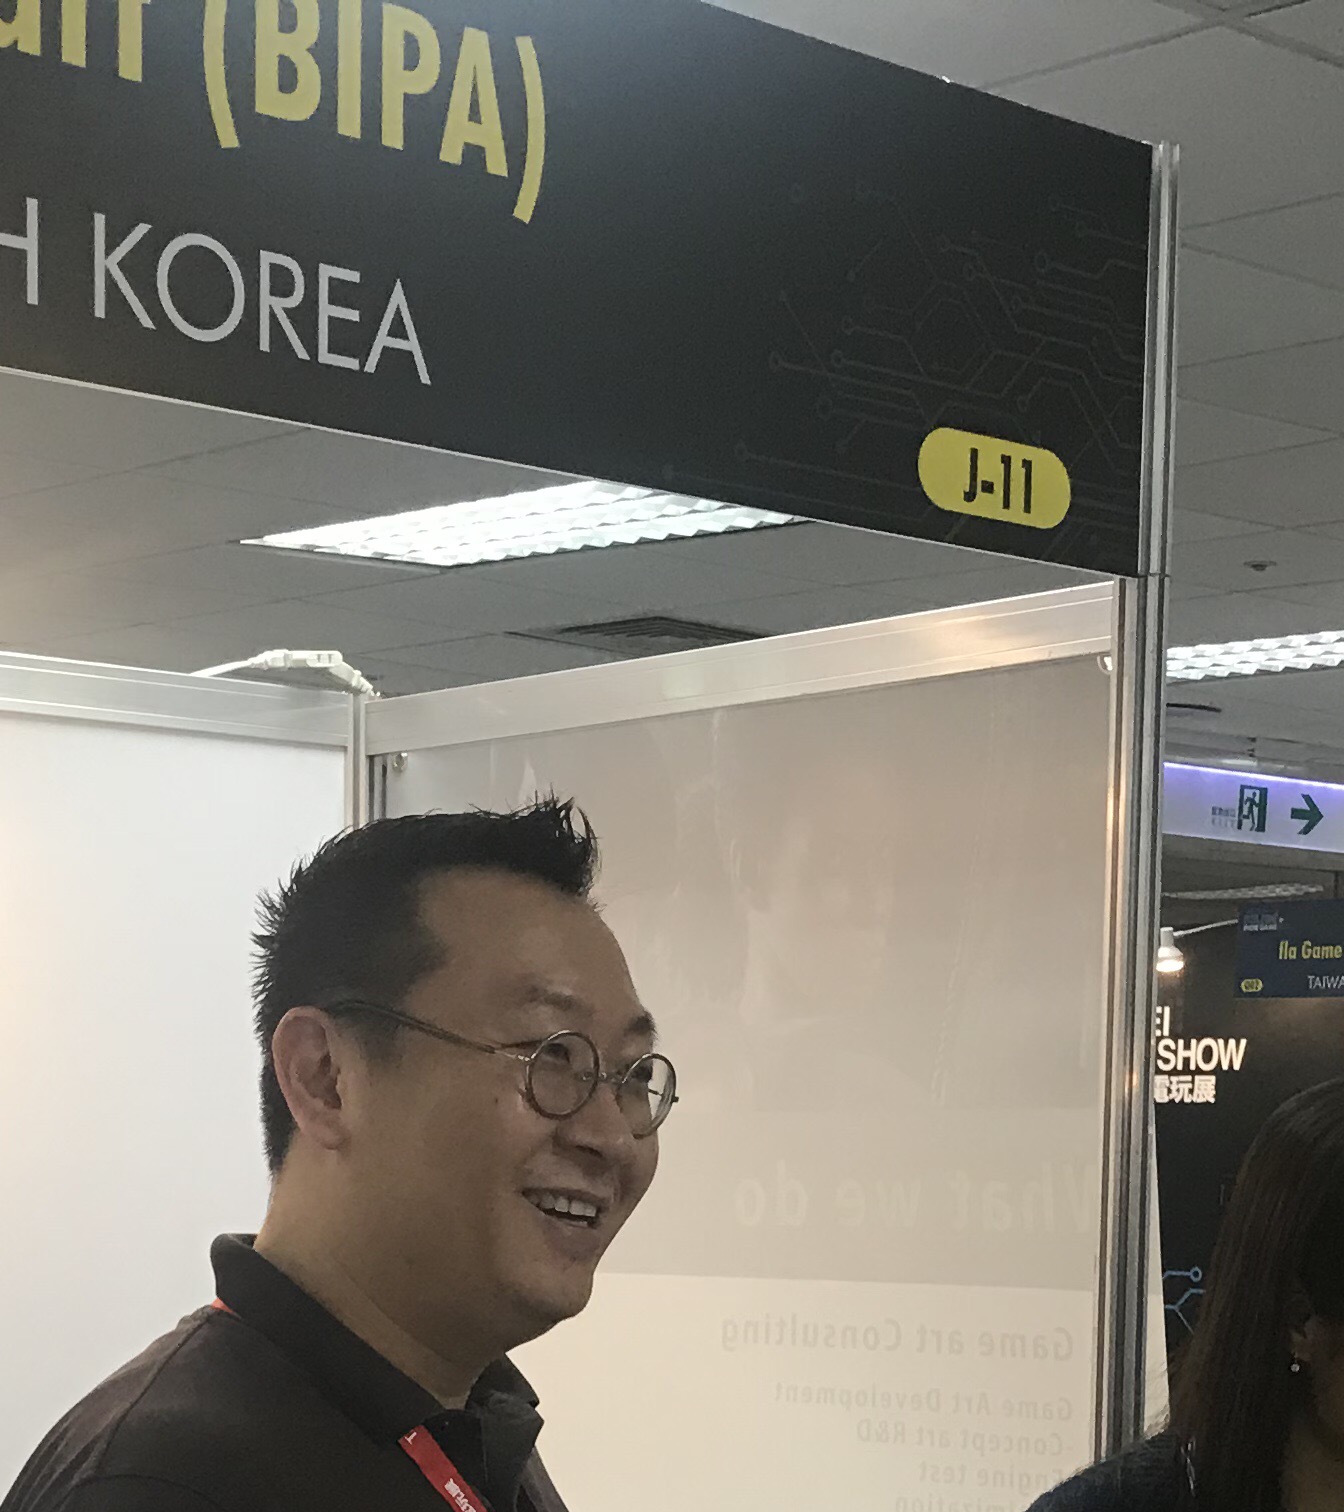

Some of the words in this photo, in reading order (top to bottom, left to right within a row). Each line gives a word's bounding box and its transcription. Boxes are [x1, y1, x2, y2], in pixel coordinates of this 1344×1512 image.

[203, 0, 545, 224] (BIPA)
[93, 211, 431, 387] KOREA
[963, 447, 1033, 514] J-11
[1301, 940, 1343, 960] Game
[1157, 1038, 1247, 1071] SHOW
